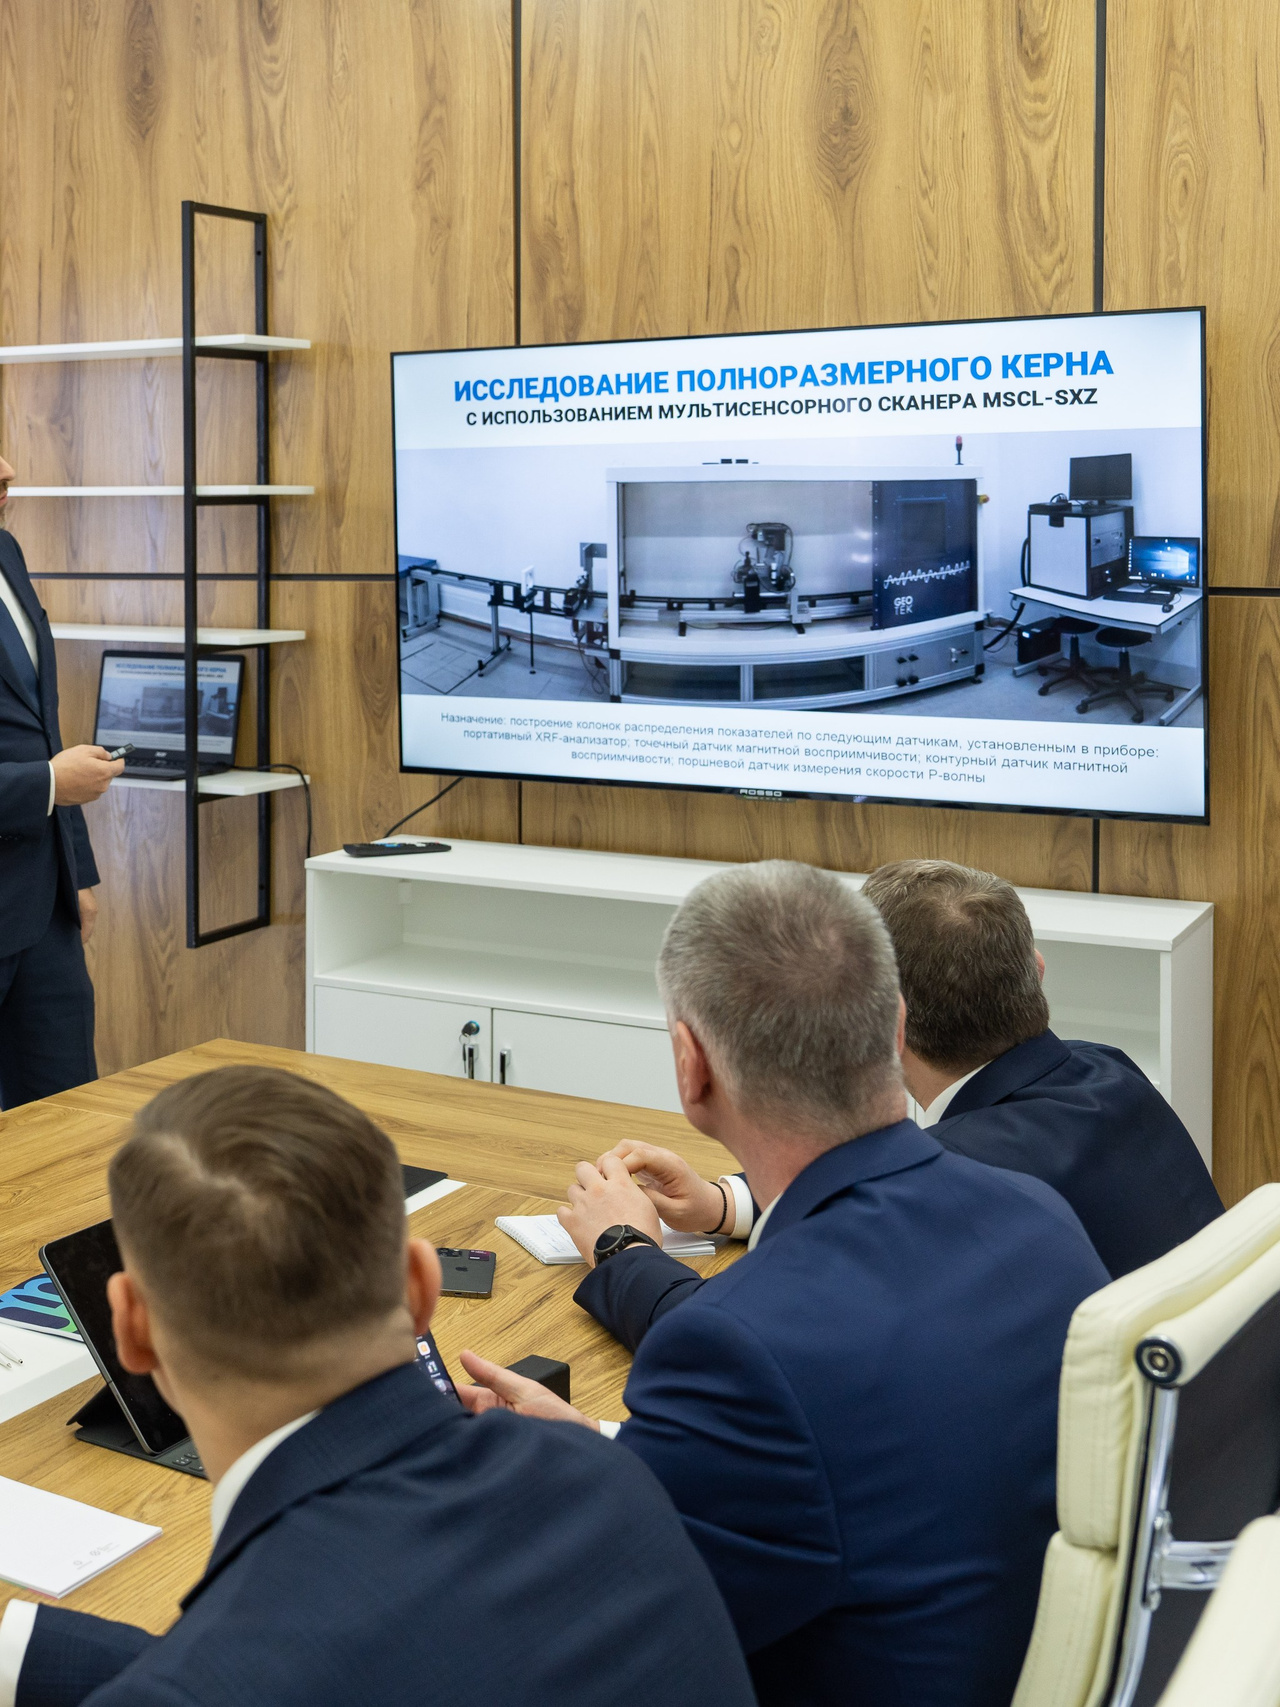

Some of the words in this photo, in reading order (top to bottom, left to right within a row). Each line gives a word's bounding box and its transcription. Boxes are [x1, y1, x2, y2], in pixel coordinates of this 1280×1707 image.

[454, 371, 669, 403] ИССЛЕДОВАНИЕ
[677, 356, 992, 393] ПОЛНОРАЗМЕРНОГО
[1001, 350, 1114, 379] КЕРНА
[466, 411, 477, 426] С
[482, 405, 653, 426] ИСПОЛЬЗОВАНИЕМ
[659, 397, 872, 420] МУЛЬТИСЕНСОРНОГО
[878, 393, 977, 411] СКАНЕРА
[983, 388, 1098, 408] MSCL-SXZ
[894, 596, 913, 606] GEO
[894, 605, 913, 615] TEK
[441, 713, 507, 725] Назначение:
[510, 718, 573, 730] построение
[576, 721, 621, 731] колонок
[624, 723, 714, 737] распределения
[718, 728, 793, 740] показателей
[797, 731, 812, 741] по
[815, 732, 891, 745] следующим
[896, 736, 963, 750] датчикам,
[967, 739, 1076, 754] установленным
[1081, 745, 1089, 755] в
[1094, 745, 1159, 759] приборе:
[463, 729, 532, 742] портативный
[535, 732, 630, 748] XRF-анализатор;
[634, 739, 689, 750] точечный
[692, 742, 733, 753] датчик
[736, 744, 800, 756] магнитной
[804, 748, 921, 763] восприимчивости;
[925, 754, 997, 768] контурный
[1001, 759, 1049, 770] датчик
[1053, 761, 1128, 774] магнитной
[571, 751, 674, 766] восприимчивости;
[678, 757, 745, 769] поршневой
[748, 760, 790, 772] датчик
[793, 764, 862, 776] измерения
[865, 767, 924, 780] скорости
